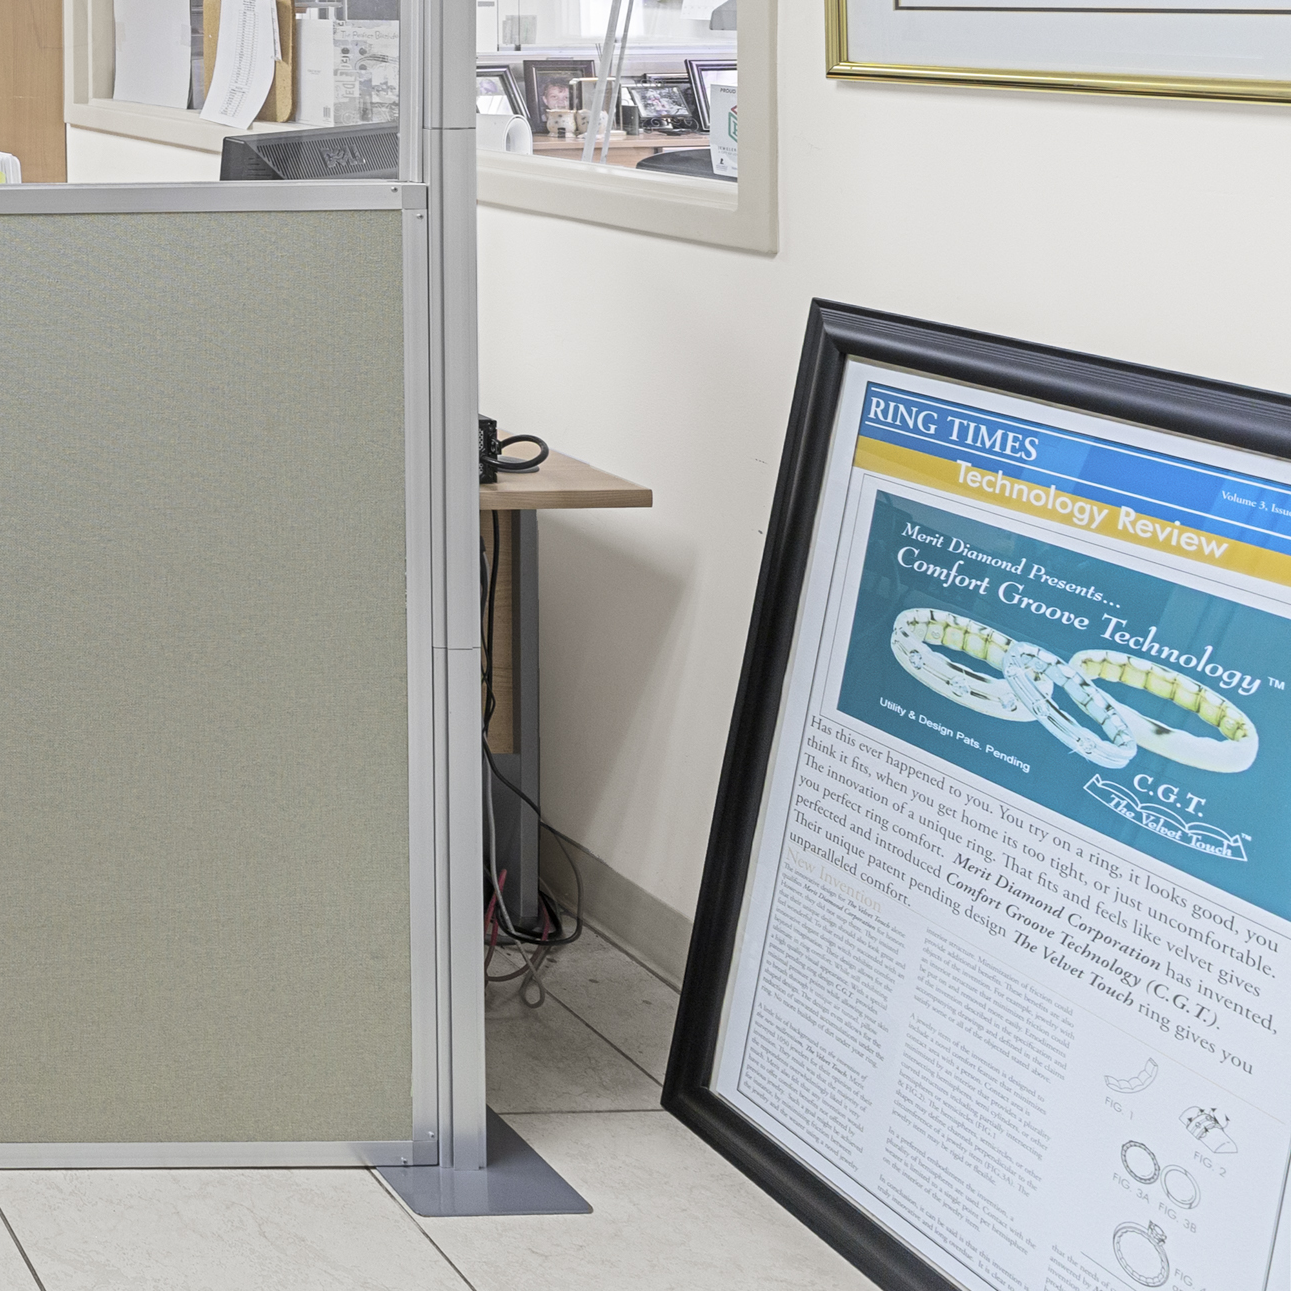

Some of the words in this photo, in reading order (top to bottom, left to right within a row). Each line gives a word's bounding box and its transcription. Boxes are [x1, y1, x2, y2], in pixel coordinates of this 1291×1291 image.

[867, 396, 938, 435] RING
[946, 415, 1039, 461] TIMES
[956, 459, 1109, 527] Technology
[1117, 505, 1229, 558] Review
[1221, 489, 1257, 508] Volume
[1258, 500, 1268, 512] 3,
[896, 545, 990, 595] Comfort
[997, 580, 1090, 630] Groove
[900, 521, 944, 548] Merit
[946, 536, 1027, 575] Diamond
[1027, 563, 1121, 609] Presents...
[878, 696, 907, 717] Utility
[907, 709, 916, 721] &
[917, 713, 954, 738] Design
[955, 730, 982, 751] Pats.
[984, 743, 1031, 774] Pending
[809, 714, 833, 736] Has
[834, 727, 856, 747] this
[858, 742, 884, 760] ever
[884, 749, 946, 791] happened
[948, 784, 962, 798] to
[963, 793, 993, 814] you.
[998, 803, 1024, 829] You
[1028, 823, 1050, 843] try
[1051, 835, 1071, 852] on
[1074, 847, 1084, 859] a
[1088, 852, 1123, 879] ring,
[1128, 868, 1141, 886] it
[1144, 874, 1188, 908] looks
[1190, 903, 1239, 935] good,
[1243, 928, 1279, 953] you
[1107, 794, 1135, 818] The
[1141, 811, 1182, 841] Velvet
[1187, 832, 1233, 858] Touch
[1133, 773, 1207, 817] C.G.T.
[785, 845, 816, 874] New
[818, 864, 882, 914] Invention
[789, 831, 858, 876] unparalleled
[859, 871, 911, 907] comfort.
[794, 793, 847, 828] perfected
[848, 822, 872, 841] and
[874, 832, 942, 879] introduced
[945, 871, 1002, 910] Comfort
[1004, 903, 1055, 939] Groove
[1059, 930, 1142, 988] Technology
[803, 751, 825, 773] The
[826, 764, 889, 807] innovation
[891, 801, 908, 814] of
[907, 809, 915, 820] a
[918, 814, 963, 844] unique
[965, 838, 996, 864] ring.
[1001, 851, 1033, 881] That
[1036, 871, 1059, 894] fits
[1062, 888, 1091, 910] and
[1094, 900, 1128, 929] feels
[1132, 918, 1162, 946] like
[1165, 940, 1214, 973] velvet
[1216, 968, 1261, 997] gives
[806, 734, 837, 759] think
[838, 750, 848, 765] it
[850, 755, 872, 778] fits,
[875, 771, 908, 795] when
[909, 789, 934, 808] you
[936, 802, 958, 819] get
[960, 808, 999, 839] home
[1001, 830, 1018, 849] its
[1021, 843, 1046, 862] too
[1049, 856, 1088, 886] tight,
[1092, 880, 1111, 895] or
[1113, 886, 1143, 912] just
[1147, 906, 1276, 979] uncomfortable.
[793, 808, 823, 835] Their
[824, 830, 865, 859] unique
[866, 853, 906, 882] patent
[907, 876, 961, 916] pending
[963, 904, 1006, 938] design
[1013, 929, 1038, 953] The
[1043, 945, 1085, 979] Velvet
[1089, 970, 1134, 1007] Touch
[1137, 1002, 1171, 1033] ring
[1173, 1024, 1215, 1053] gives
[1219, 1049, 1253, 1075] you
[798, 774, 820, 792] you
[821, 787, 862, 814] perfect
[864, 808, 889, 832] ring
[891, 824, 944, 858] comfort.
[952, 852, 992, 881] Merit
[994, 873, 1066, 919] Diamond
[1067, 912, 1161, 971] Corporation
[1164, 960, 1191, 988] has
[1197, 979, 1277, 1035] invented,
[1104, 1095, 1123, 1113] FIG.
[1129, 1110, 1134, 1120] 1
[1111, 1171, 1132, 1192] FIG.
[1135, 1187, 1150, 1204] 3A
[1192, 1150, 1215, 1172] FIG.
[1218, 1166, 1227, 1178] 2
[1157, 1201, 1179, 1223] FIG.
[1182, 1217, 1197, 1234] 3B
